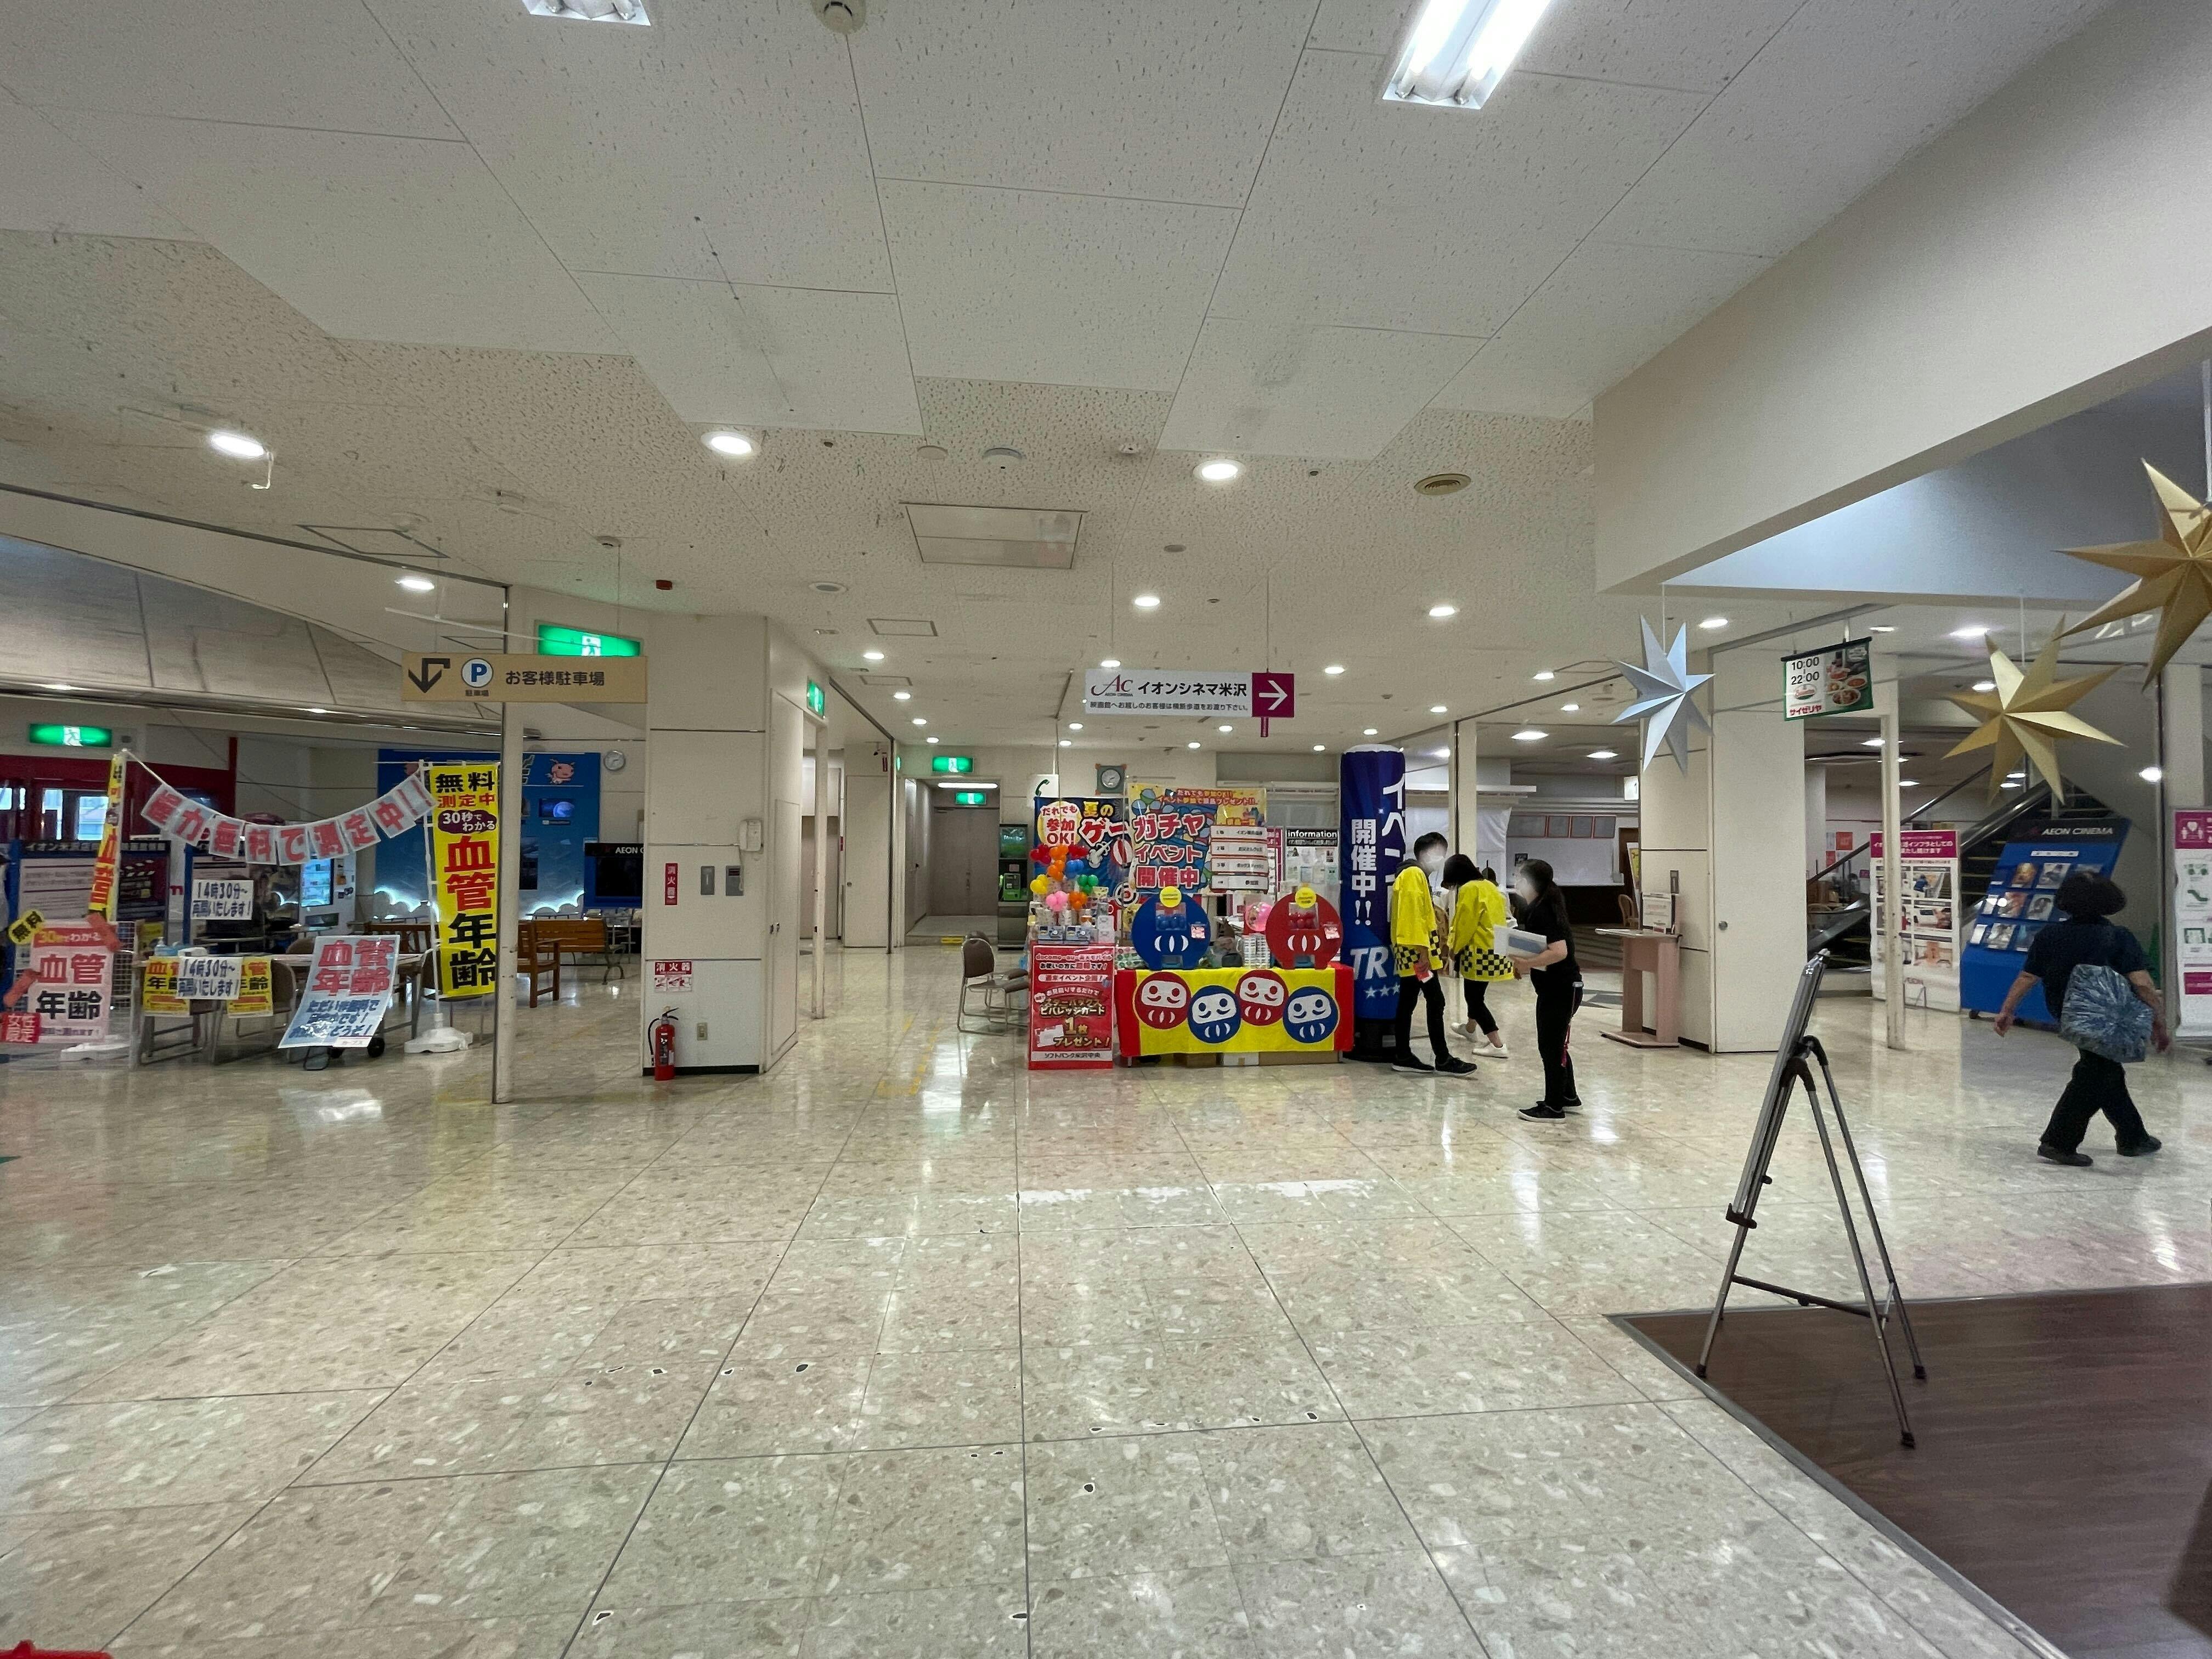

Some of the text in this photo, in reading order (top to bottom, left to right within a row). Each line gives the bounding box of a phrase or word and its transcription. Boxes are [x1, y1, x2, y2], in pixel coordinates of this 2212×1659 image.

[471, 663, 487, 682] P
[505, 670, 605, 686] お客様駐車場
[1138, 681, 1247, 697] イオンシネマ米沢
[1790, 705, 1822, 716] サイゼリヤ
[436, 771, 495, 793] 無料
[438, 793, 495, 808] 測定中
[443, 812, 482, 824] 30秒で
[1042, 806, 1077, 816] だれでも
[462, 821, 495, 832] わかる
[1047, 819, 1075, 831] 参加
[1134, 815, 1205, 840] ガチャ
[1288, 830, 1338, 838] information
[1047, 833, 1074, 844] OK!
[1136, 845, 1201, 863] イベント
[1137, 866, 1199, 888] 開催中
[1351, 819, 1377, 926] 開催中!!
[444, 835, 496, 989] 血管年齢
[318, 939, 395, 966] 血管
[38, 953, 107, 984] 血管
[311, 967, 391, 996] 年齢
[36, 991, 102, 1019] 年齢
